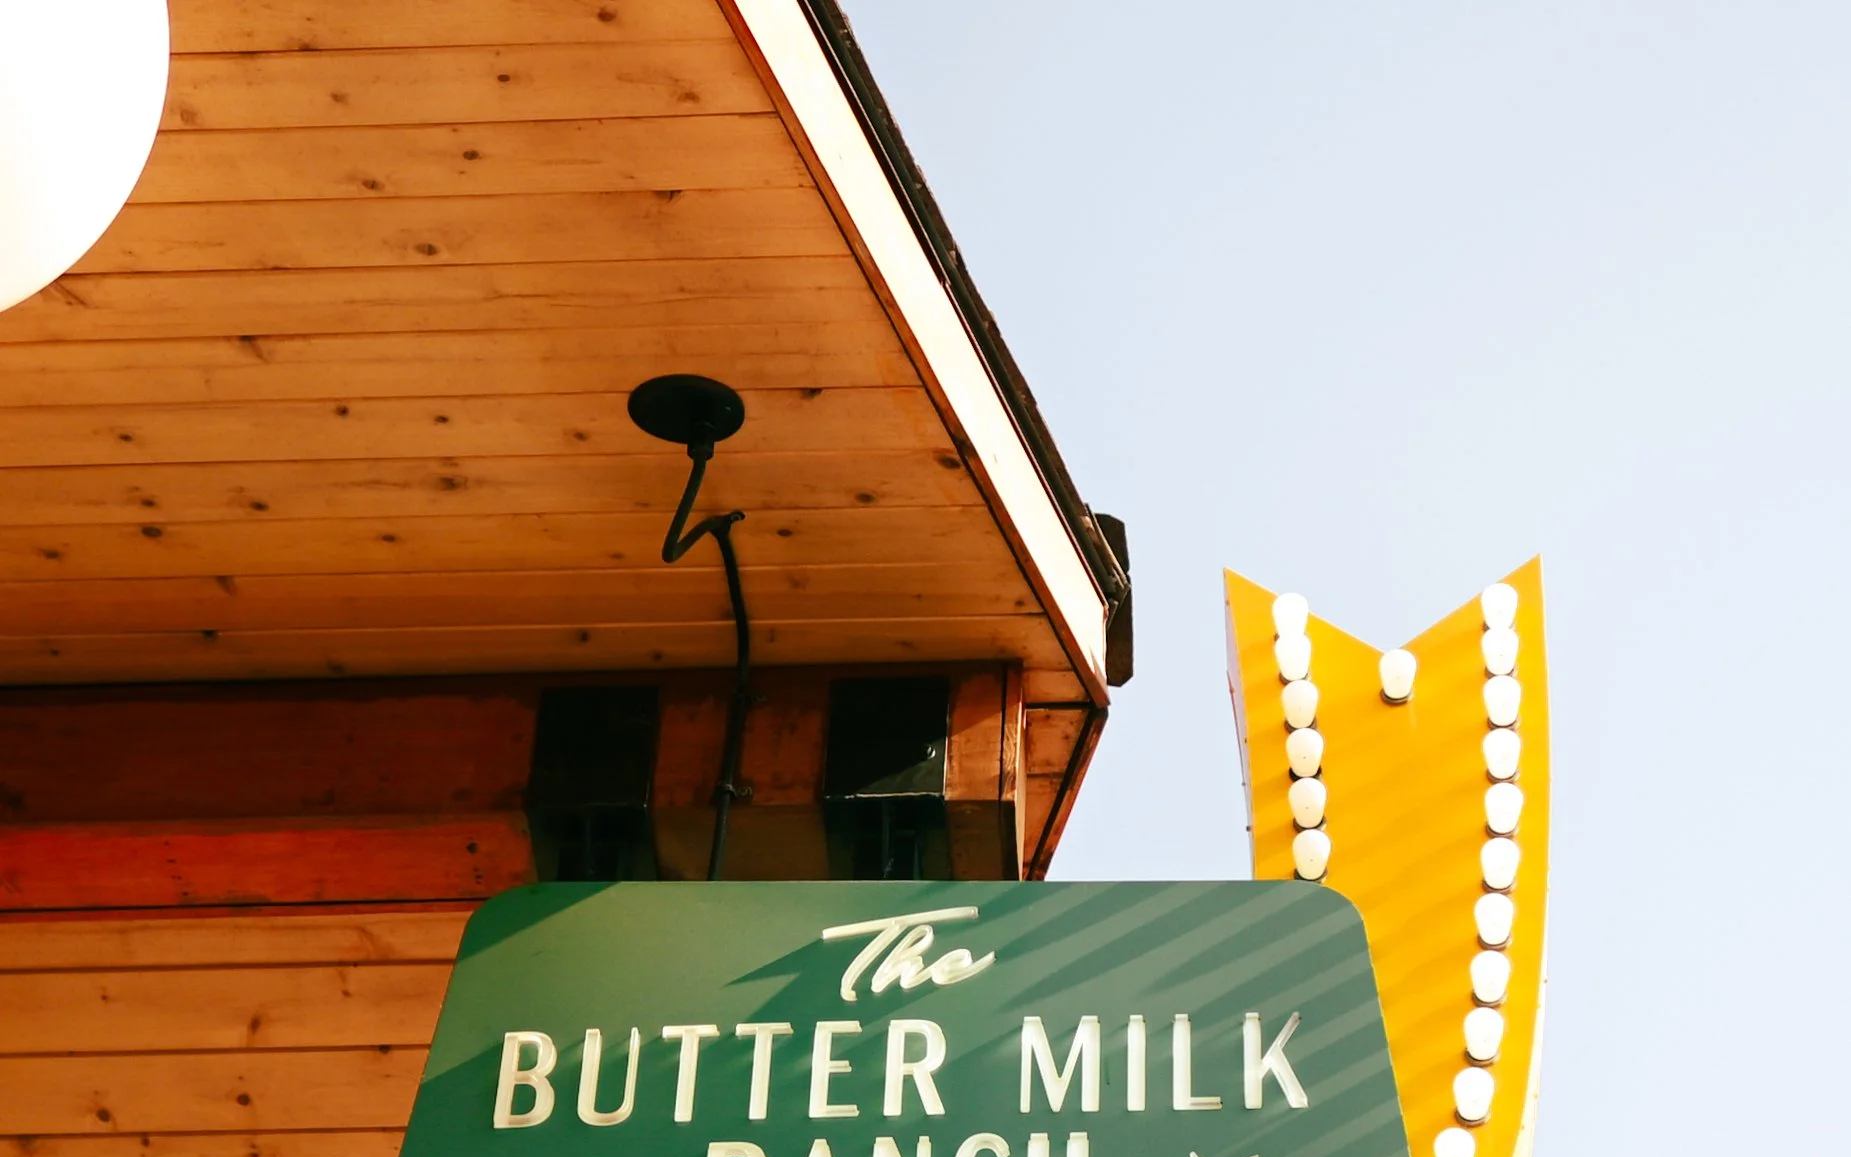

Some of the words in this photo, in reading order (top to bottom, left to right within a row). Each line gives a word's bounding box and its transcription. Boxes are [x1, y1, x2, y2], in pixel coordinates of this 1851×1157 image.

[820, 906, 996, 1002] The
[493, 1019, 947, 1130] BUTTER
[1019, 1011, 1310, 1113] MILK
